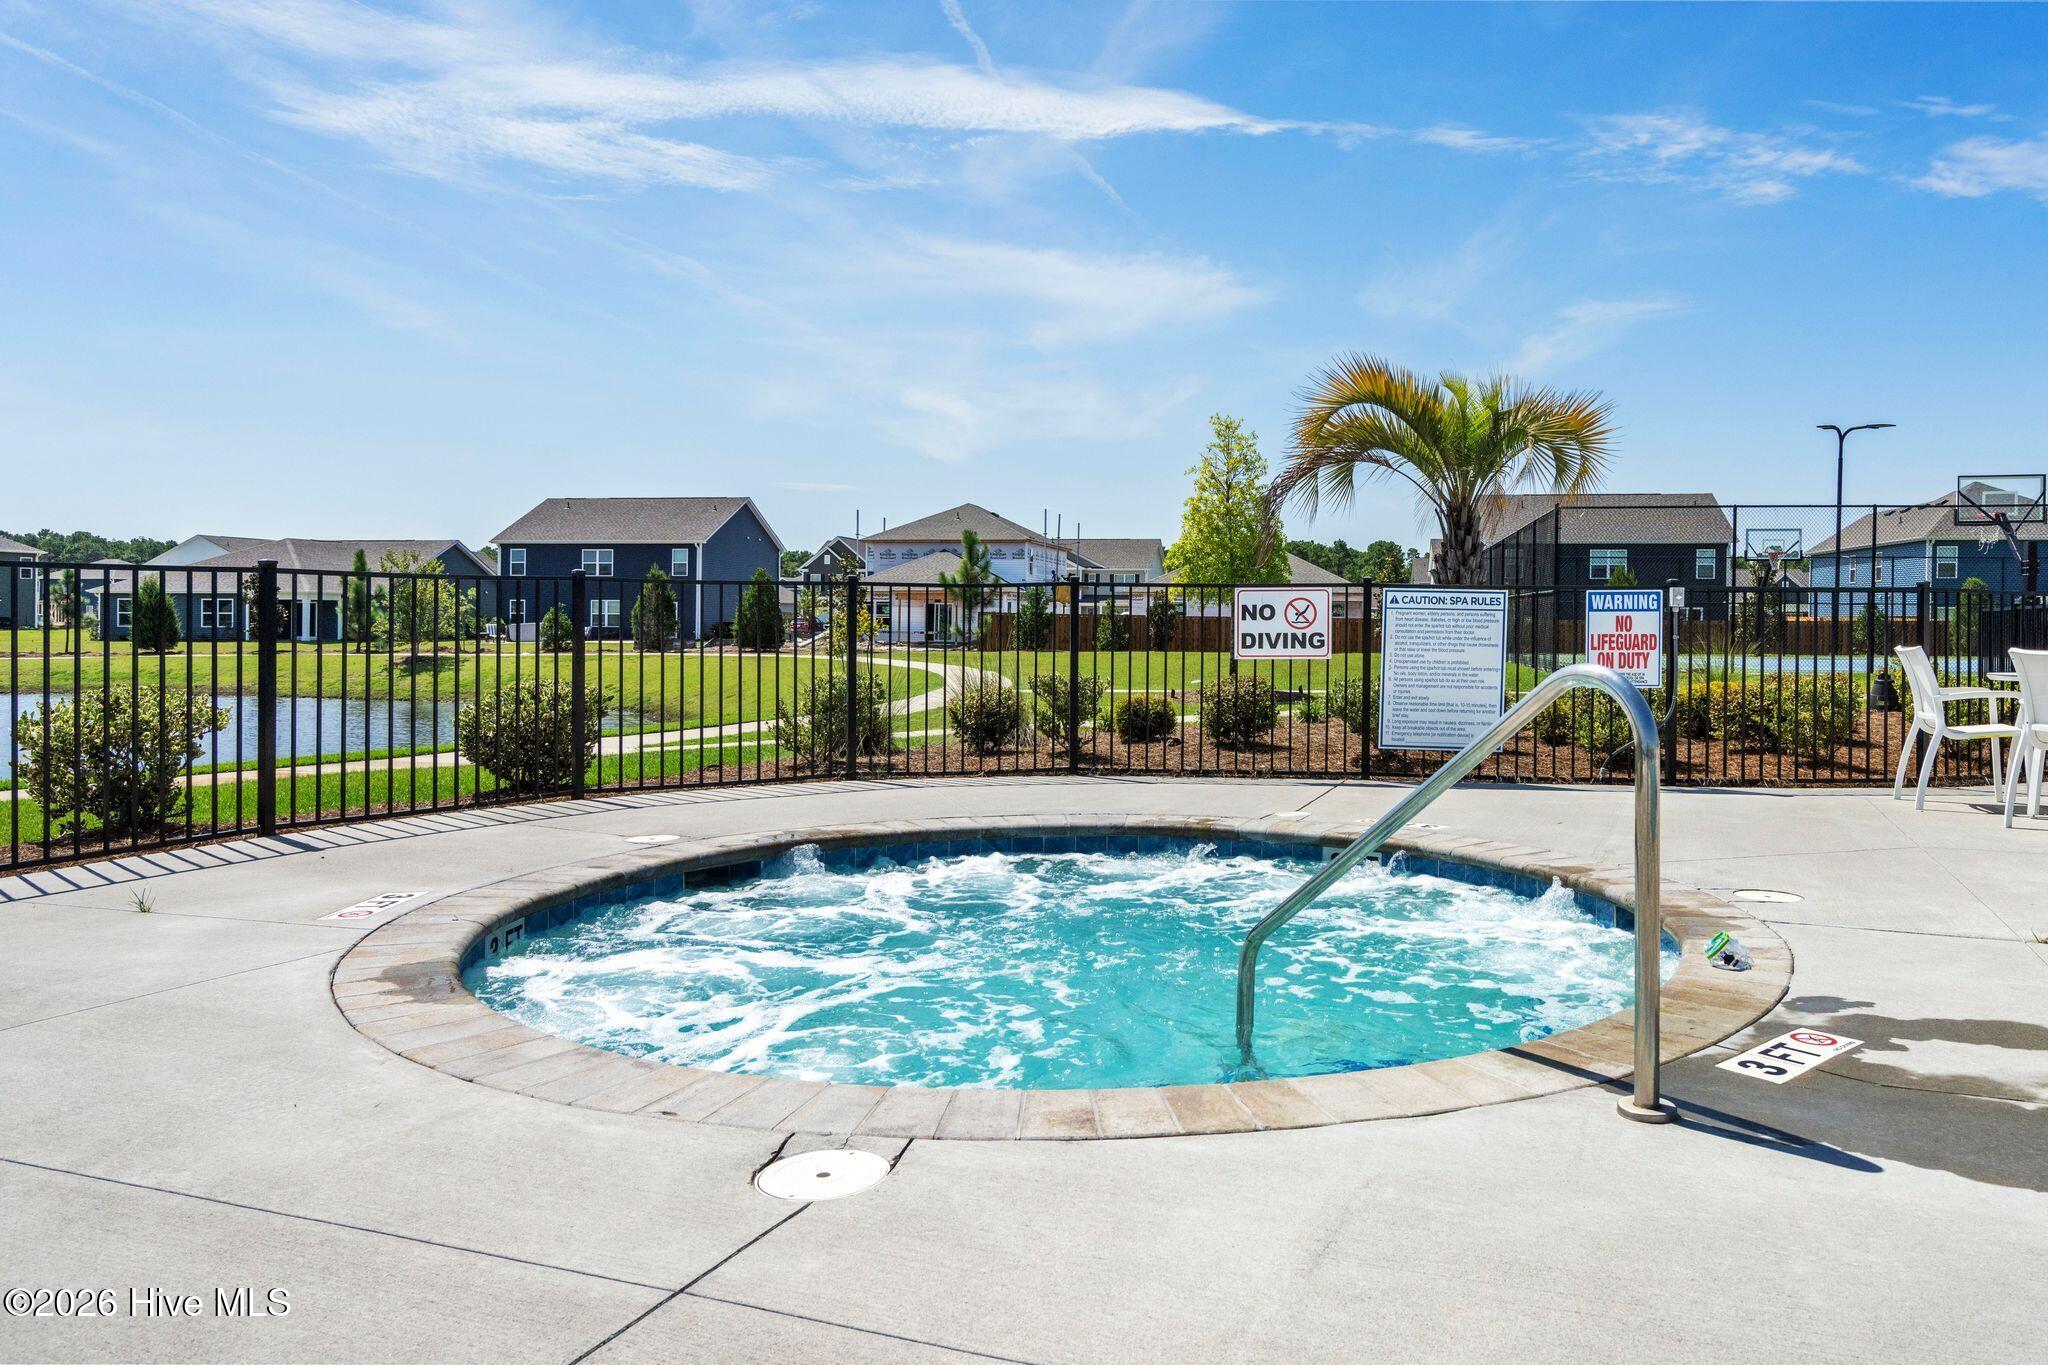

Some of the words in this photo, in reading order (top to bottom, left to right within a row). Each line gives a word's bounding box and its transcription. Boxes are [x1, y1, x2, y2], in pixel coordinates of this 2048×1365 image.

[1402, 596, 1448, 605] CAUTION:
[1450, 596, 1468, 606] SPA
[1470, 597, 1502, 606] RULES
[1591, 594, 1658, 610] WARNING
[1242, 604, 1276, 620] NO
[1616, 615, 1632, 632] NO
[1241, 632, 1326, 649] DIVING
[1590, 634, 1657, 650] LIFEGUARD
[1597, 652, 1614, 669] ON
[1618, 652, 1650, 669] DUTY
[1758, 1042, 1821, 1065] FT
[1738, 1060, 1788, 1076] 3
